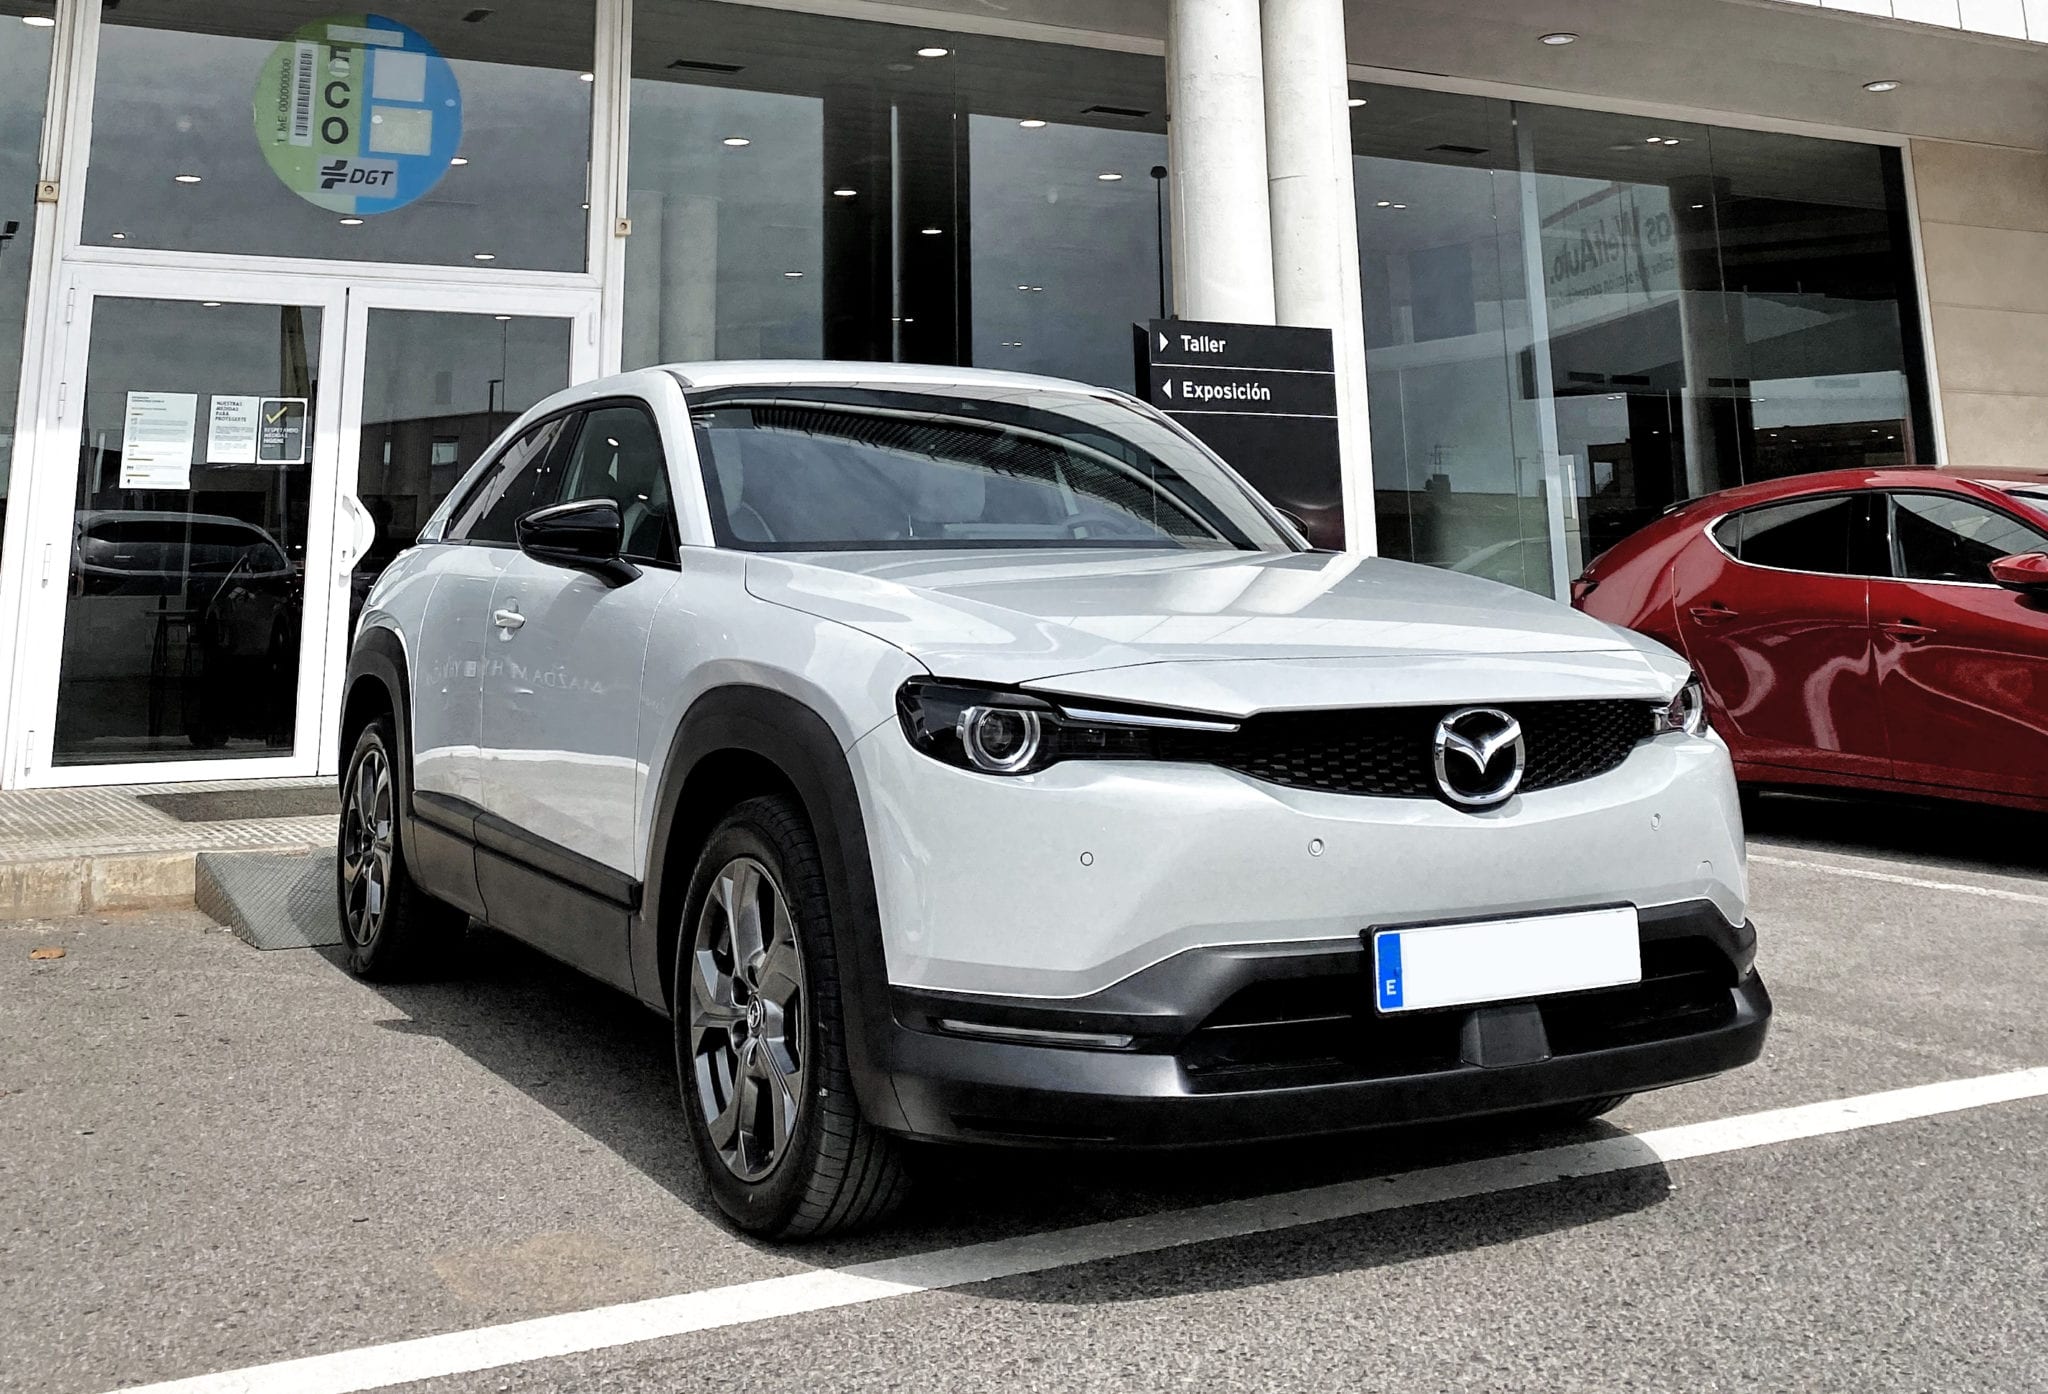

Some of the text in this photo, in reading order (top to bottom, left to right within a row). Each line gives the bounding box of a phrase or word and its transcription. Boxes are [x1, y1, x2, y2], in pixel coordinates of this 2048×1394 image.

[322, 45, 351, 144] ECO
[349, 168, 394, 186] DGT
[1180, 334, 1226, 353] Taller
[1182, 381, 1271, 402] Exposición
[1386, 979, 1397, 995] E
